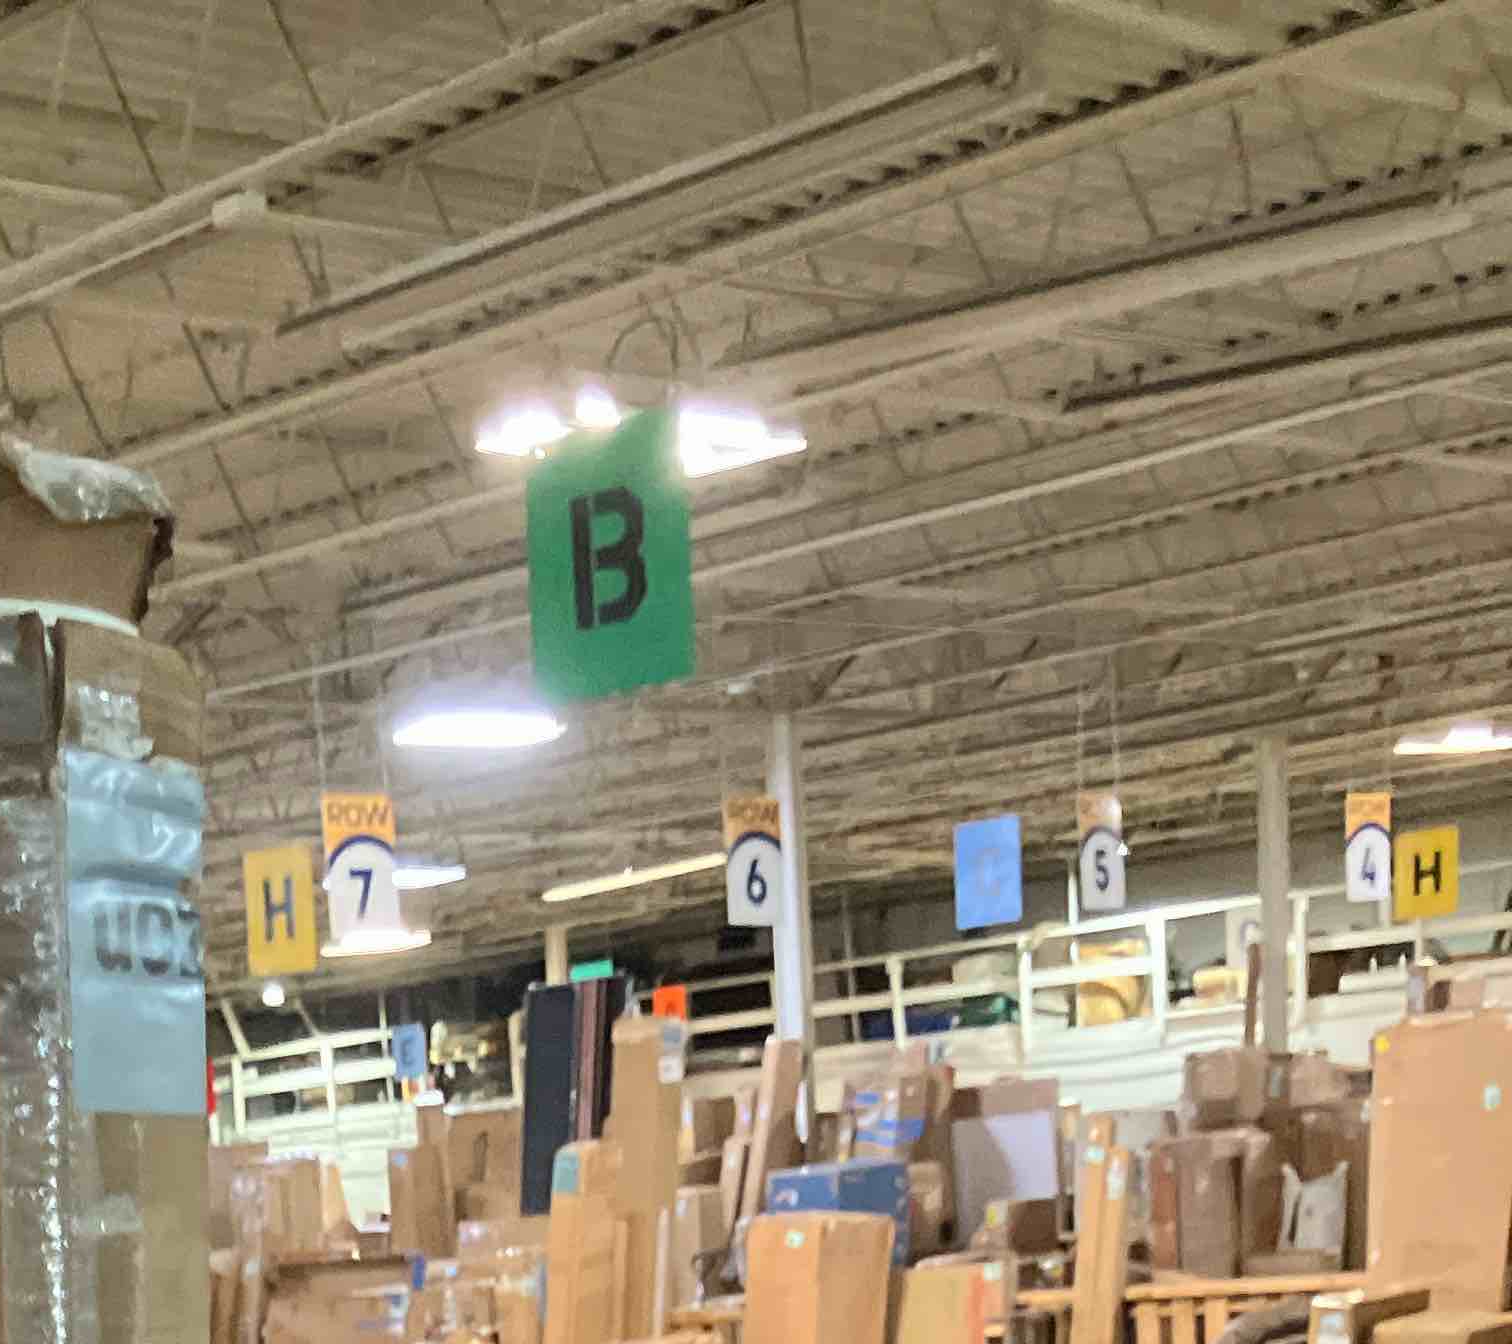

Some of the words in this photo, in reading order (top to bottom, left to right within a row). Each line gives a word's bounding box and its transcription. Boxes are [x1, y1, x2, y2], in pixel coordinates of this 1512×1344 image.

[570, 487, 647, 630] B
[327, 801, 389, 826] ROW
[747, 859, 768, 904] 6
[1094, 849, 1110, 891] 5
[1361, 847, 1376, 887] 4
[1414, 851, 1441, 896] H
[263, 875, 294, 943] H
[349, 869, 372, 919] 7
